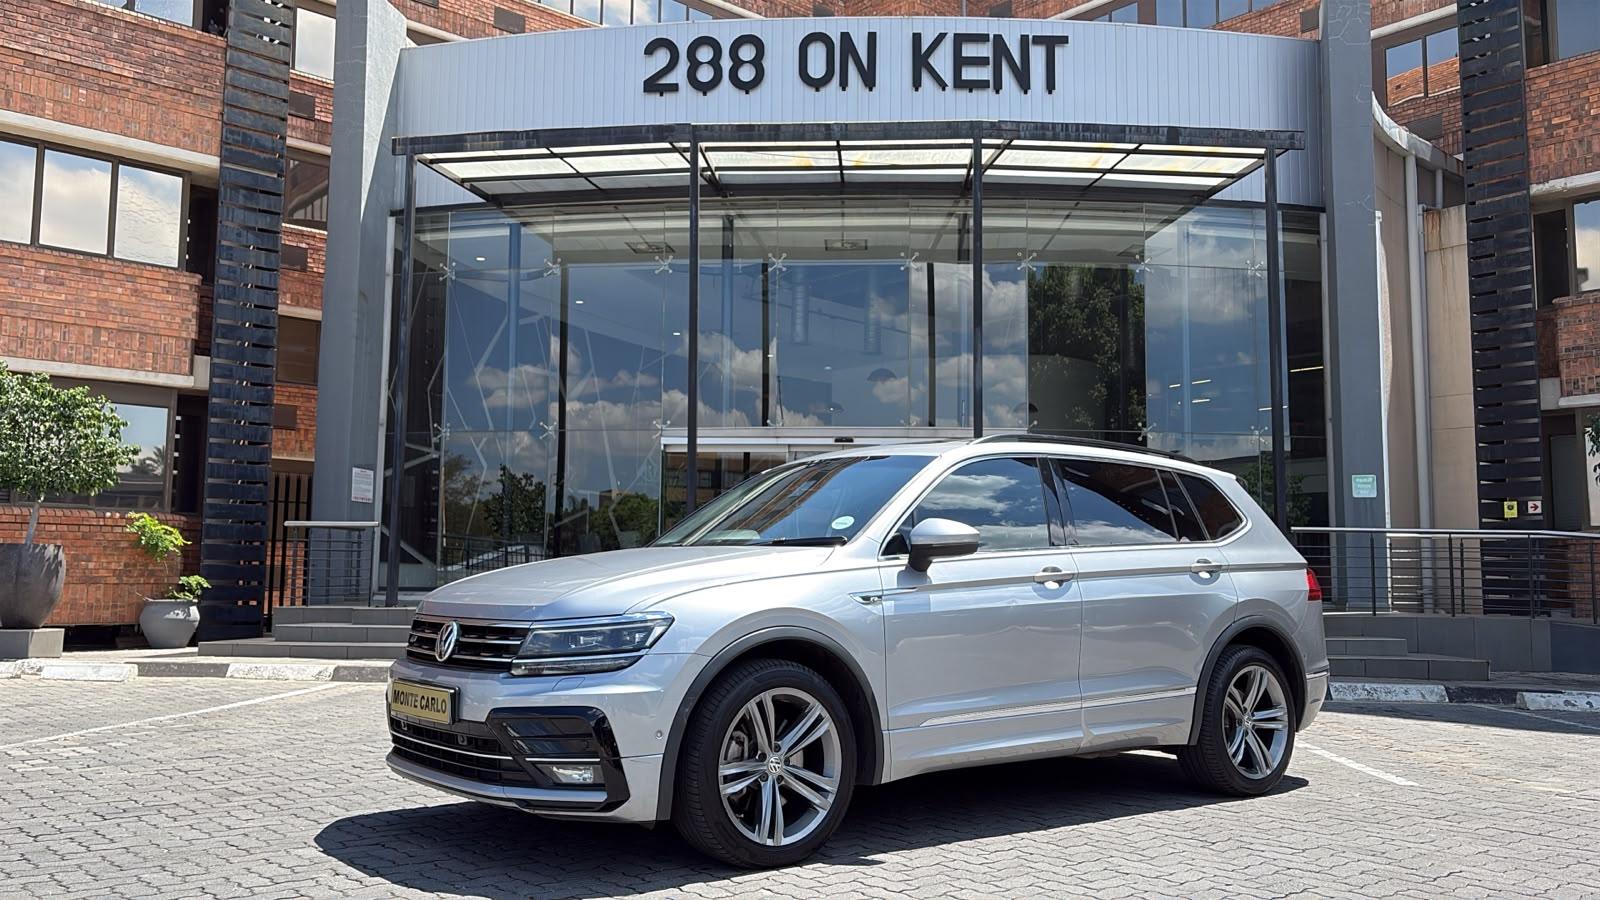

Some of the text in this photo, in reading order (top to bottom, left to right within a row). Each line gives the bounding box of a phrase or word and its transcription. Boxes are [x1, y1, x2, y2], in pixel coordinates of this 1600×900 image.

[643, 31, 1069, 93] 288 ON KENT
[393, 689, 446, 713] MONTE CARLO
